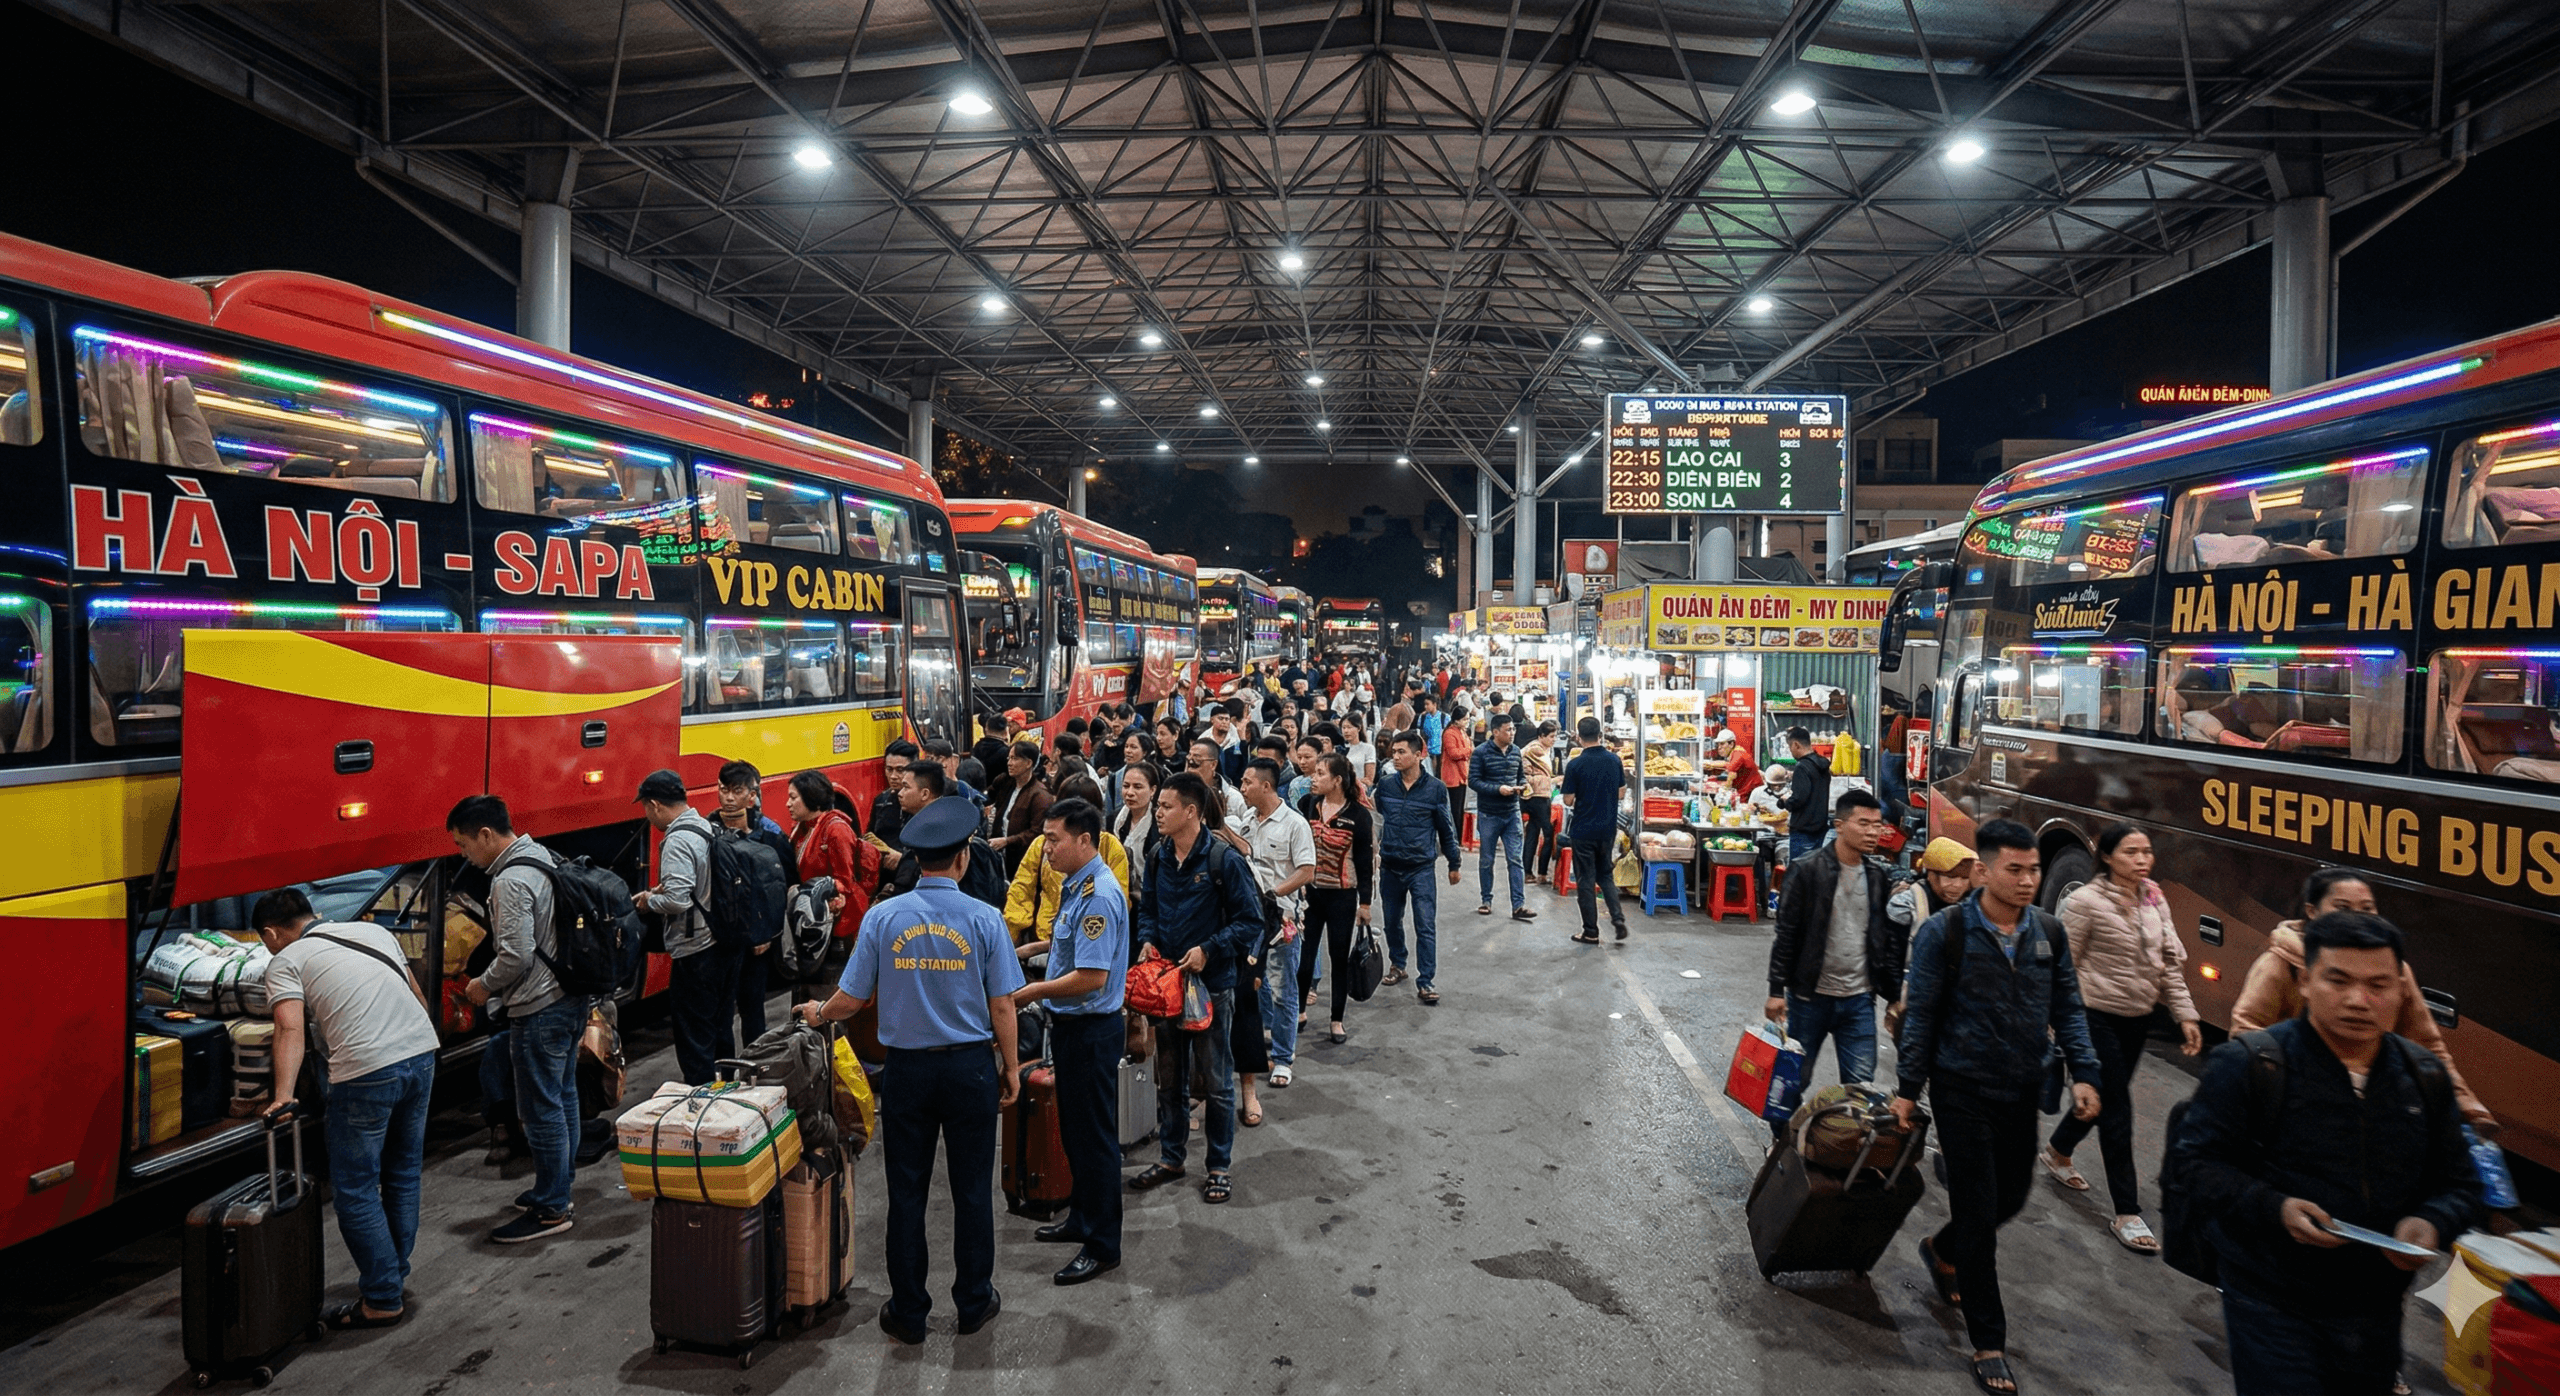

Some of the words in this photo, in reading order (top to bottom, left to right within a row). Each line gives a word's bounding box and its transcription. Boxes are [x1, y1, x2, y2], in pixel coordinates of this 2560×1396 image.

[2140, 384, 2175, 402] QUÁN
[1754, 400, 1798, 411] STATION
[1611, 450, 1661, 466] 22:15
[1666, 451, 1705, 467] LAO
[1709, 451, 1741, 467] CAI
[1779, 452, 1792, 468] 3
[1611, 470, 1661, 487] 22:30
[1780, 472, 1792, 488] 2
[1611, 491, 1660, 507] 23:00
[1666, 491, 1705, 508] SON
[1711, 492, 1736, 508] LA
[1779, 493, 1792, 509] 4
[69, 474, 237, 578] HÀ
[264, 498, 421, 602] NỘI
[494, 530, 655, 601] SAPA
[707, 556, 778, 607] VIP
[786, 565, 885, 613] CABIN
[1662, 592, 1713, 619] QUÁN
[1718, 593, 1744, 619] ĂN
[1750, 593, 1791, 620] ĐÊM
[1809, 600, 1839, 620] MY
[1843, 600, 1887, 620] DINH
[2171, 573, 2218, 633] HÀ
[2228, 569, 2299, 644] NỘI
[2347, 558, 2414, 632] HÀ
[2202, 778, 2420, 867] SLEEPING
[2440, 815, 2560, 897] BUS
[894, 957, 917, 970] BUS
[919, 957, 966, 971] STATION
